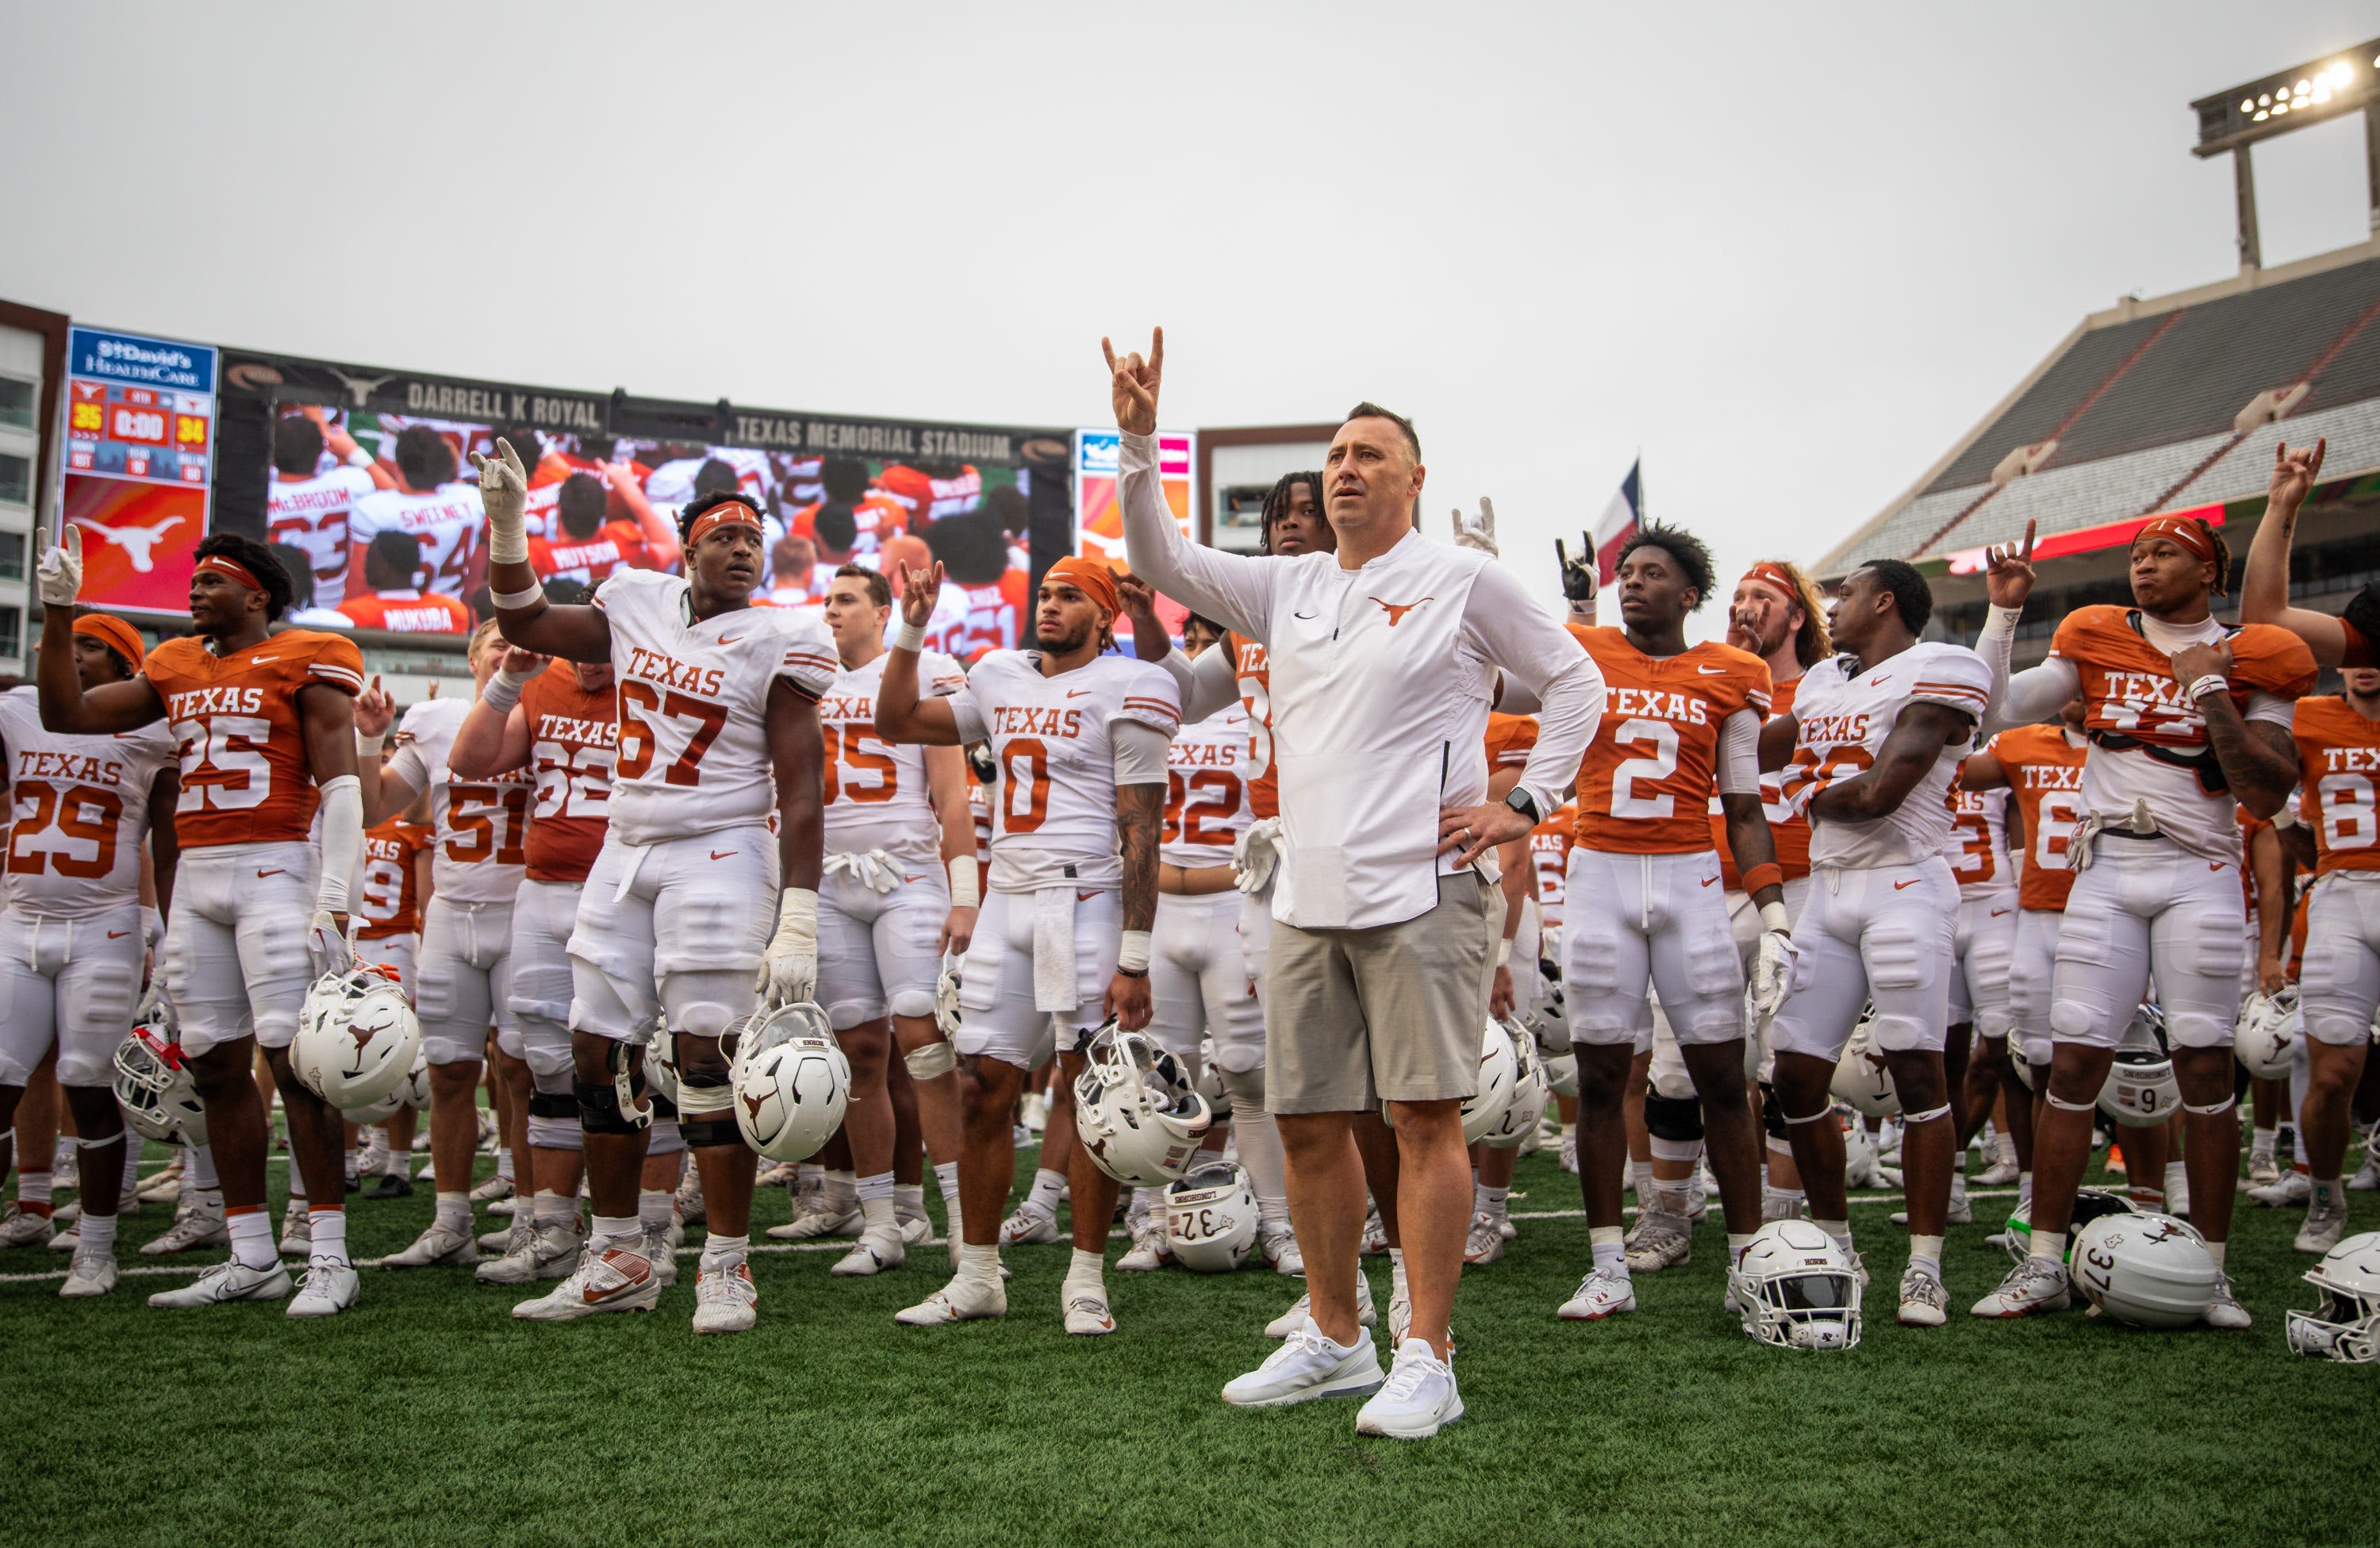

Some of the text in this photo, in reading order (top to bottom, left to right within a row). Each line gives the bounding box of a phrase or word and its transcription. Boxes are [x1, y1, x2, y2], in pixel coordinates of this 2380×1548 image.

[73, 402, 102, 430] 35
[115, 409, 163, 440] 0:00
[408, 381, 600, 428] DARRELL K ROYAL
[177, 416, 205, 444] 34
[737, 417, 1010, 459] TEXAS MEMORIAL STADIUM
[401, 501, 471, 528] SWEENEY
[628, 647, 725, 697] TEXAS
[2105, 671, 2203, 713] TEXA
[170, 687, 263, 720] TEXAS
[993, 706, 1081, 739] TEXAS
[1602, 687, 1707, 725] TEXAS
[539, 714, 618, 747] TEXAS
[616, 679, 728, 786] 67
[1796, 714, 1869, 744] TEXAS
[19, 751, 122, 786] TEXAS
[174, 716, 271, 813] 25
[1610, 718, 1679, 819] 2
[1002, 738, 1050, 834] 0
[8, 781, 123, 879] 29
[446, 786, 529, 864] 51
[1175, 1191, 1216, 1204] LONGHORNS
[2083, 1247, 2114, 1292] 37
